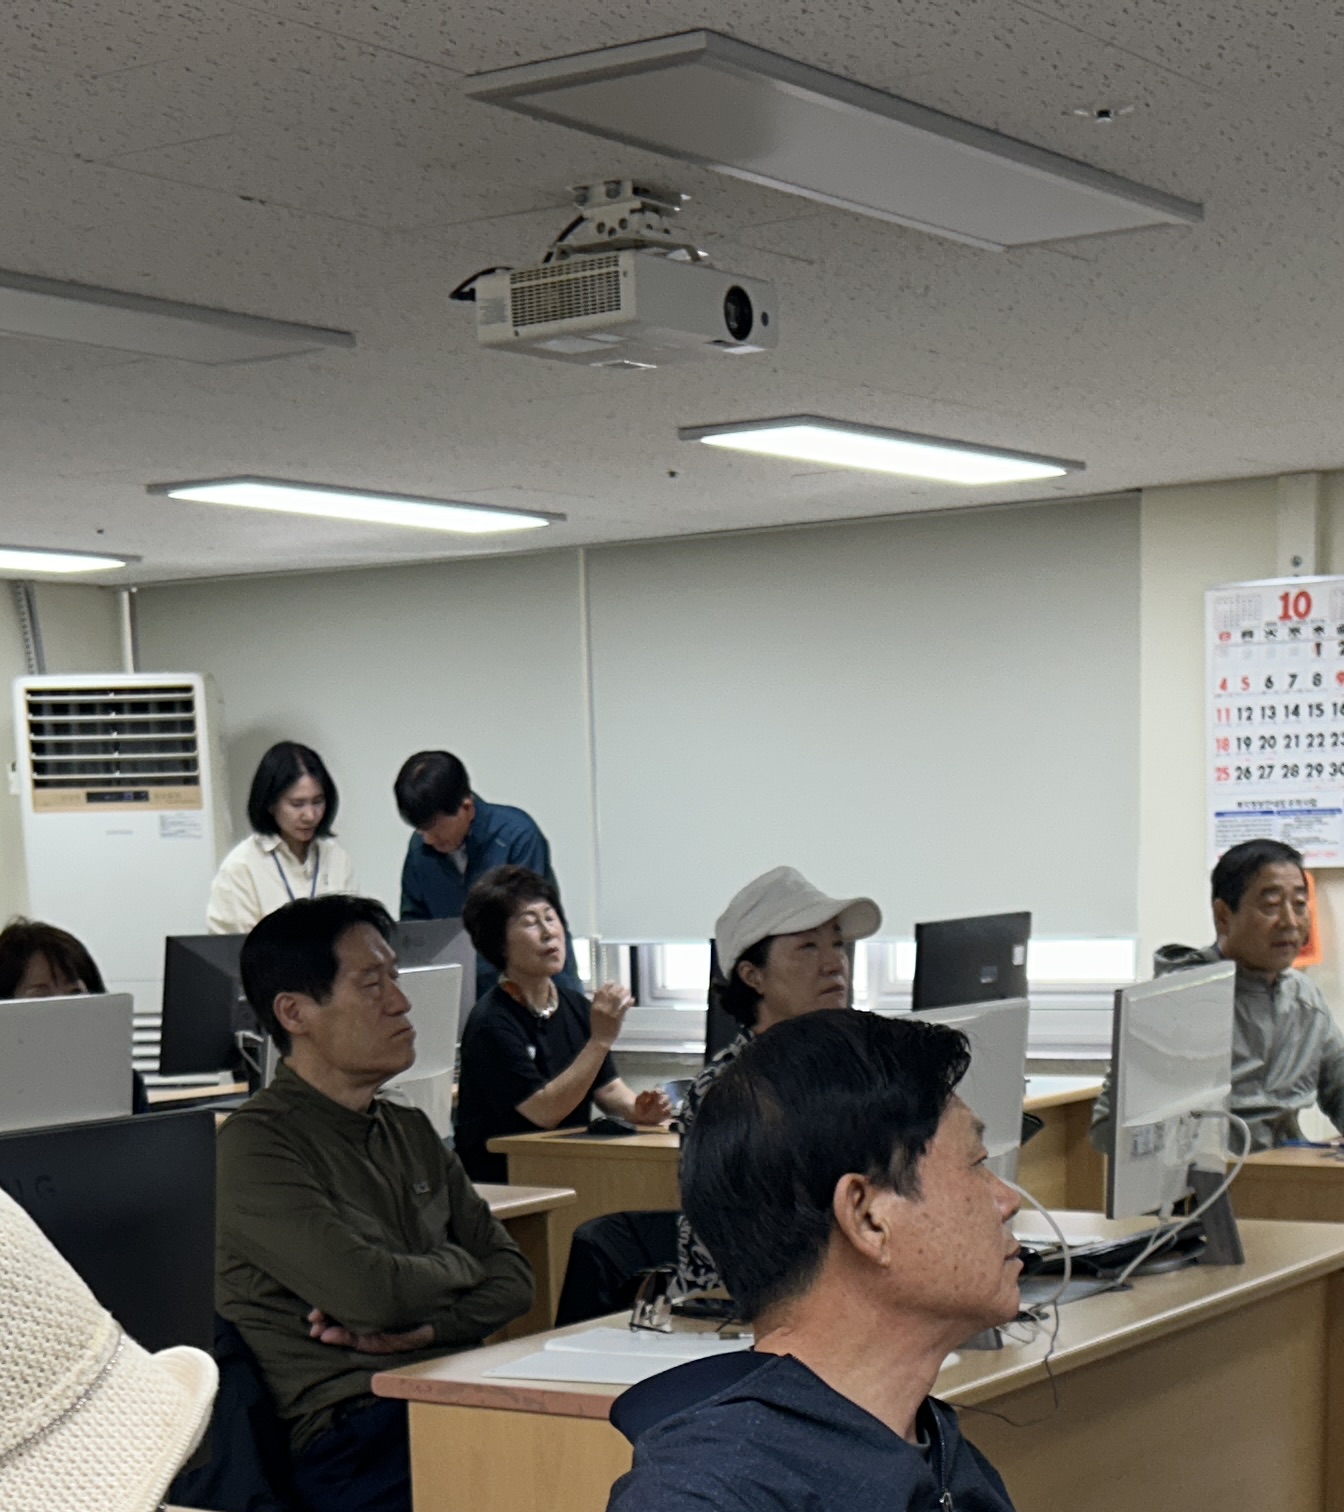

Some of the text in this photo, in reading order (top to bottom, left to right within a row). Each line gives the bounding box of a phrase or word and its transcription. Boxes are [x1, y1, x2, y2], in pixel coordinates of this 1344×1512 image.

[1278, 590, 1312, 621] 10
[1316, 641, 1322, 657] 1
[1241, 676, 1250, 690] 5
[1265, 675, 1274, 688] 6
[1288, 674, 1298, 688] 7
[1313, 672, 1322, 687] 8
[1217, 708, 1230, 722] 11
[1237, 706, 1253, 721] 12
[1260, 706, 1276, 720] 13
[1284, 704, 1300, 719] 14
[1308, 703, 1324, 717] 15
[1216, 738, 1229, 752] 18
[1236, 737, 1252, 751] 19
[1258, 735, 1277, 750] 20
[1283, 734, 1300, 749] 21
[1306, 733, 1325, 748] 22
[1216, 768, 1229, 781] 25
[1235, 766, 1252, 781] 26
[1258, 765, 1274, 779] 27
[1281, 764, 1299, 778] 28
[1306, 763, 1324, 778] 29
